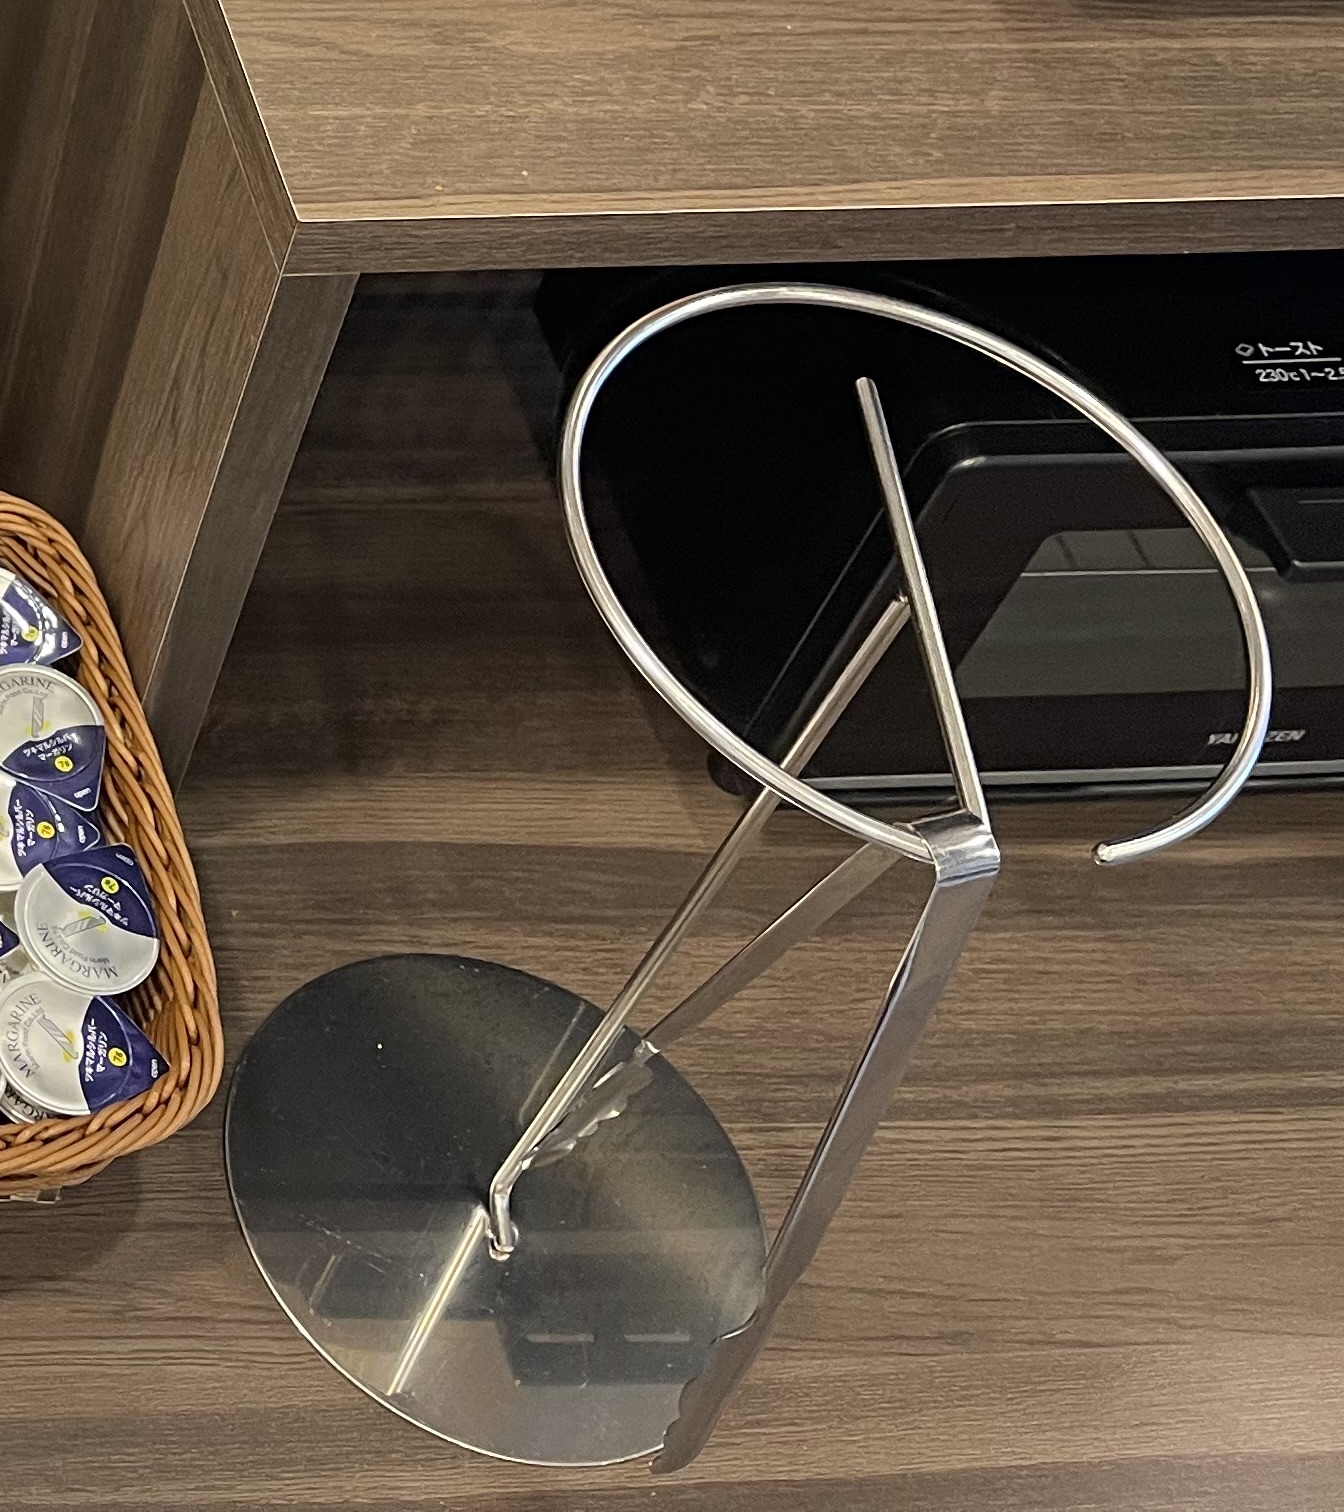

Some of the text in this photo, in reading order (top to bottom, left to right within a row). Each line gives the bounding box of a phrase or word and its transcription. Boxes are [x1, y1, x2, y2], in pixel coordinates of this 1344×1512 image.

[1207, 729, 1306, 745] YAZEN
[37, 921, 119, 979] MARGARINE
[6, 992, 42, 1079] MARGARINE
